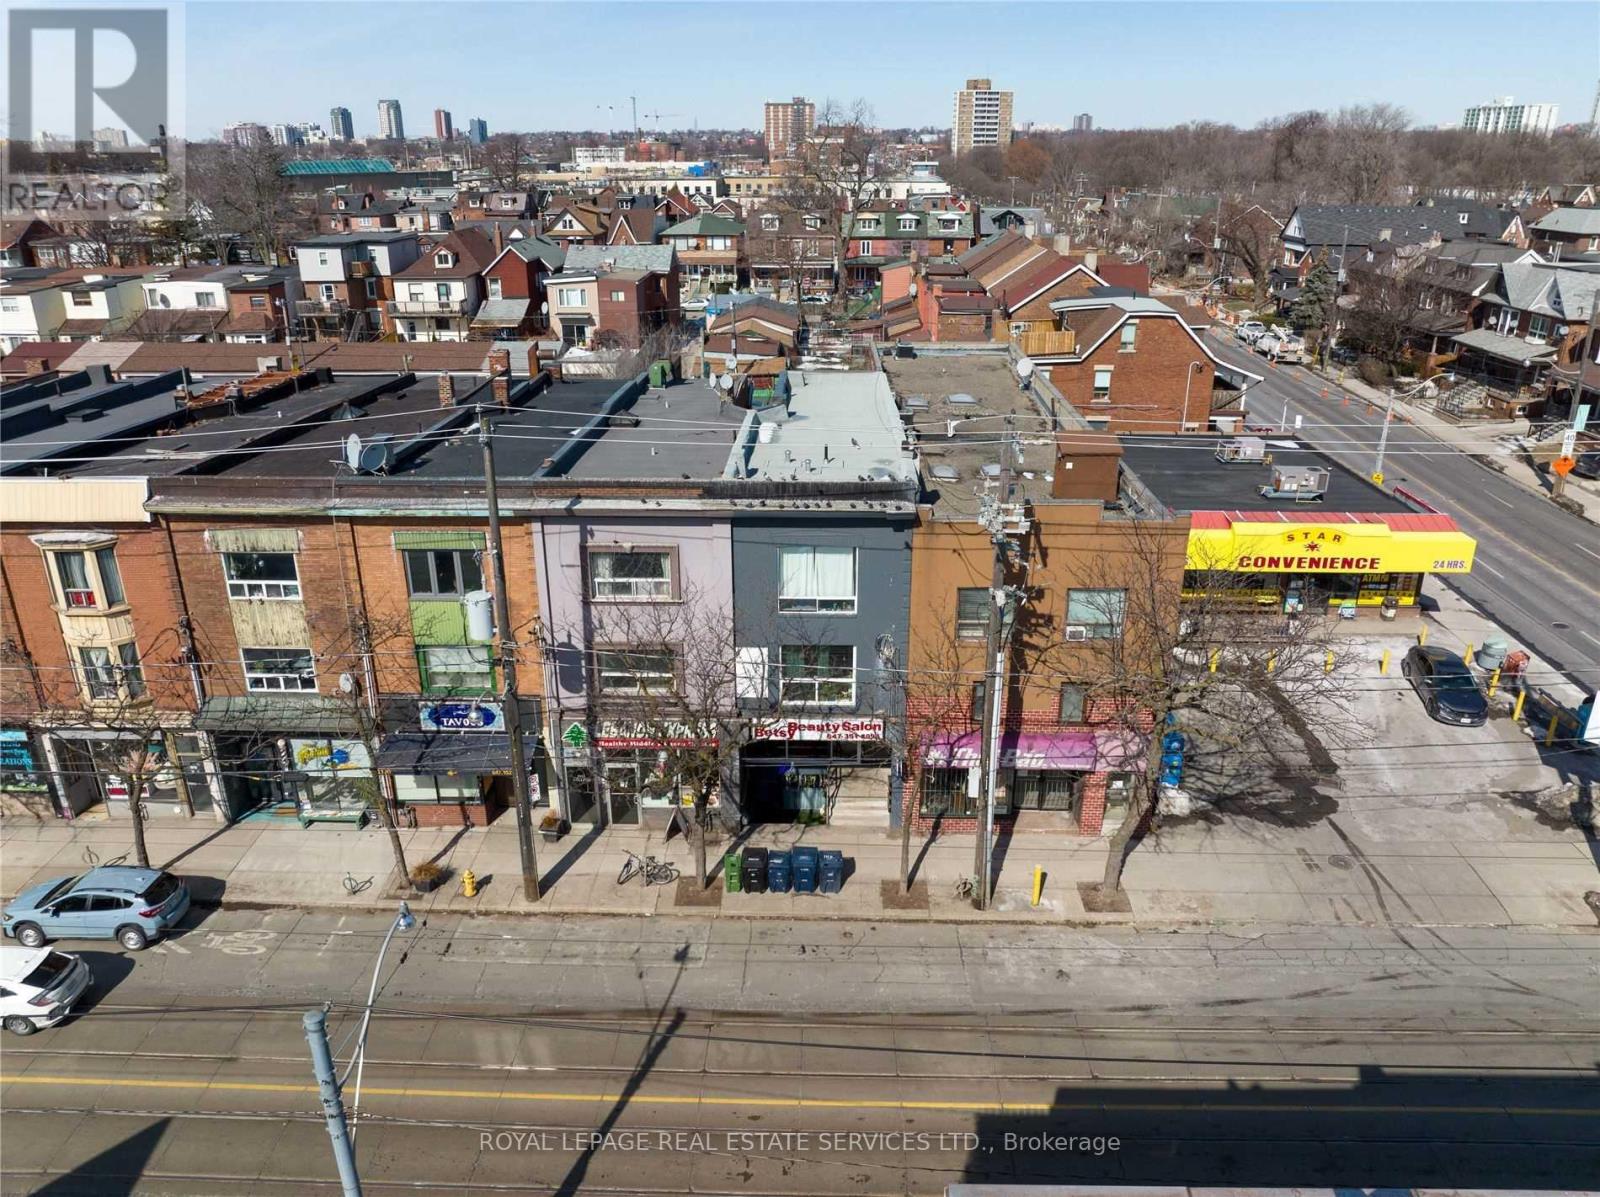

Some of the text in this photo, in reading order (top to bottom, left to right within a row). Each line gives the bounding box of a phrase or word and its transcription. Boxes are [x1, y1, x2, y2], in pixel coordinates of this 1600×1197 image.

[1286, 532, 1342, 543] STAR
[1238, 556, 1380, 570] CONVENIENCE
[1433, 560, 1445, 569] 24
[787, 722, 840, 733] Beauty
[842, 721, 882, 732] Salon
